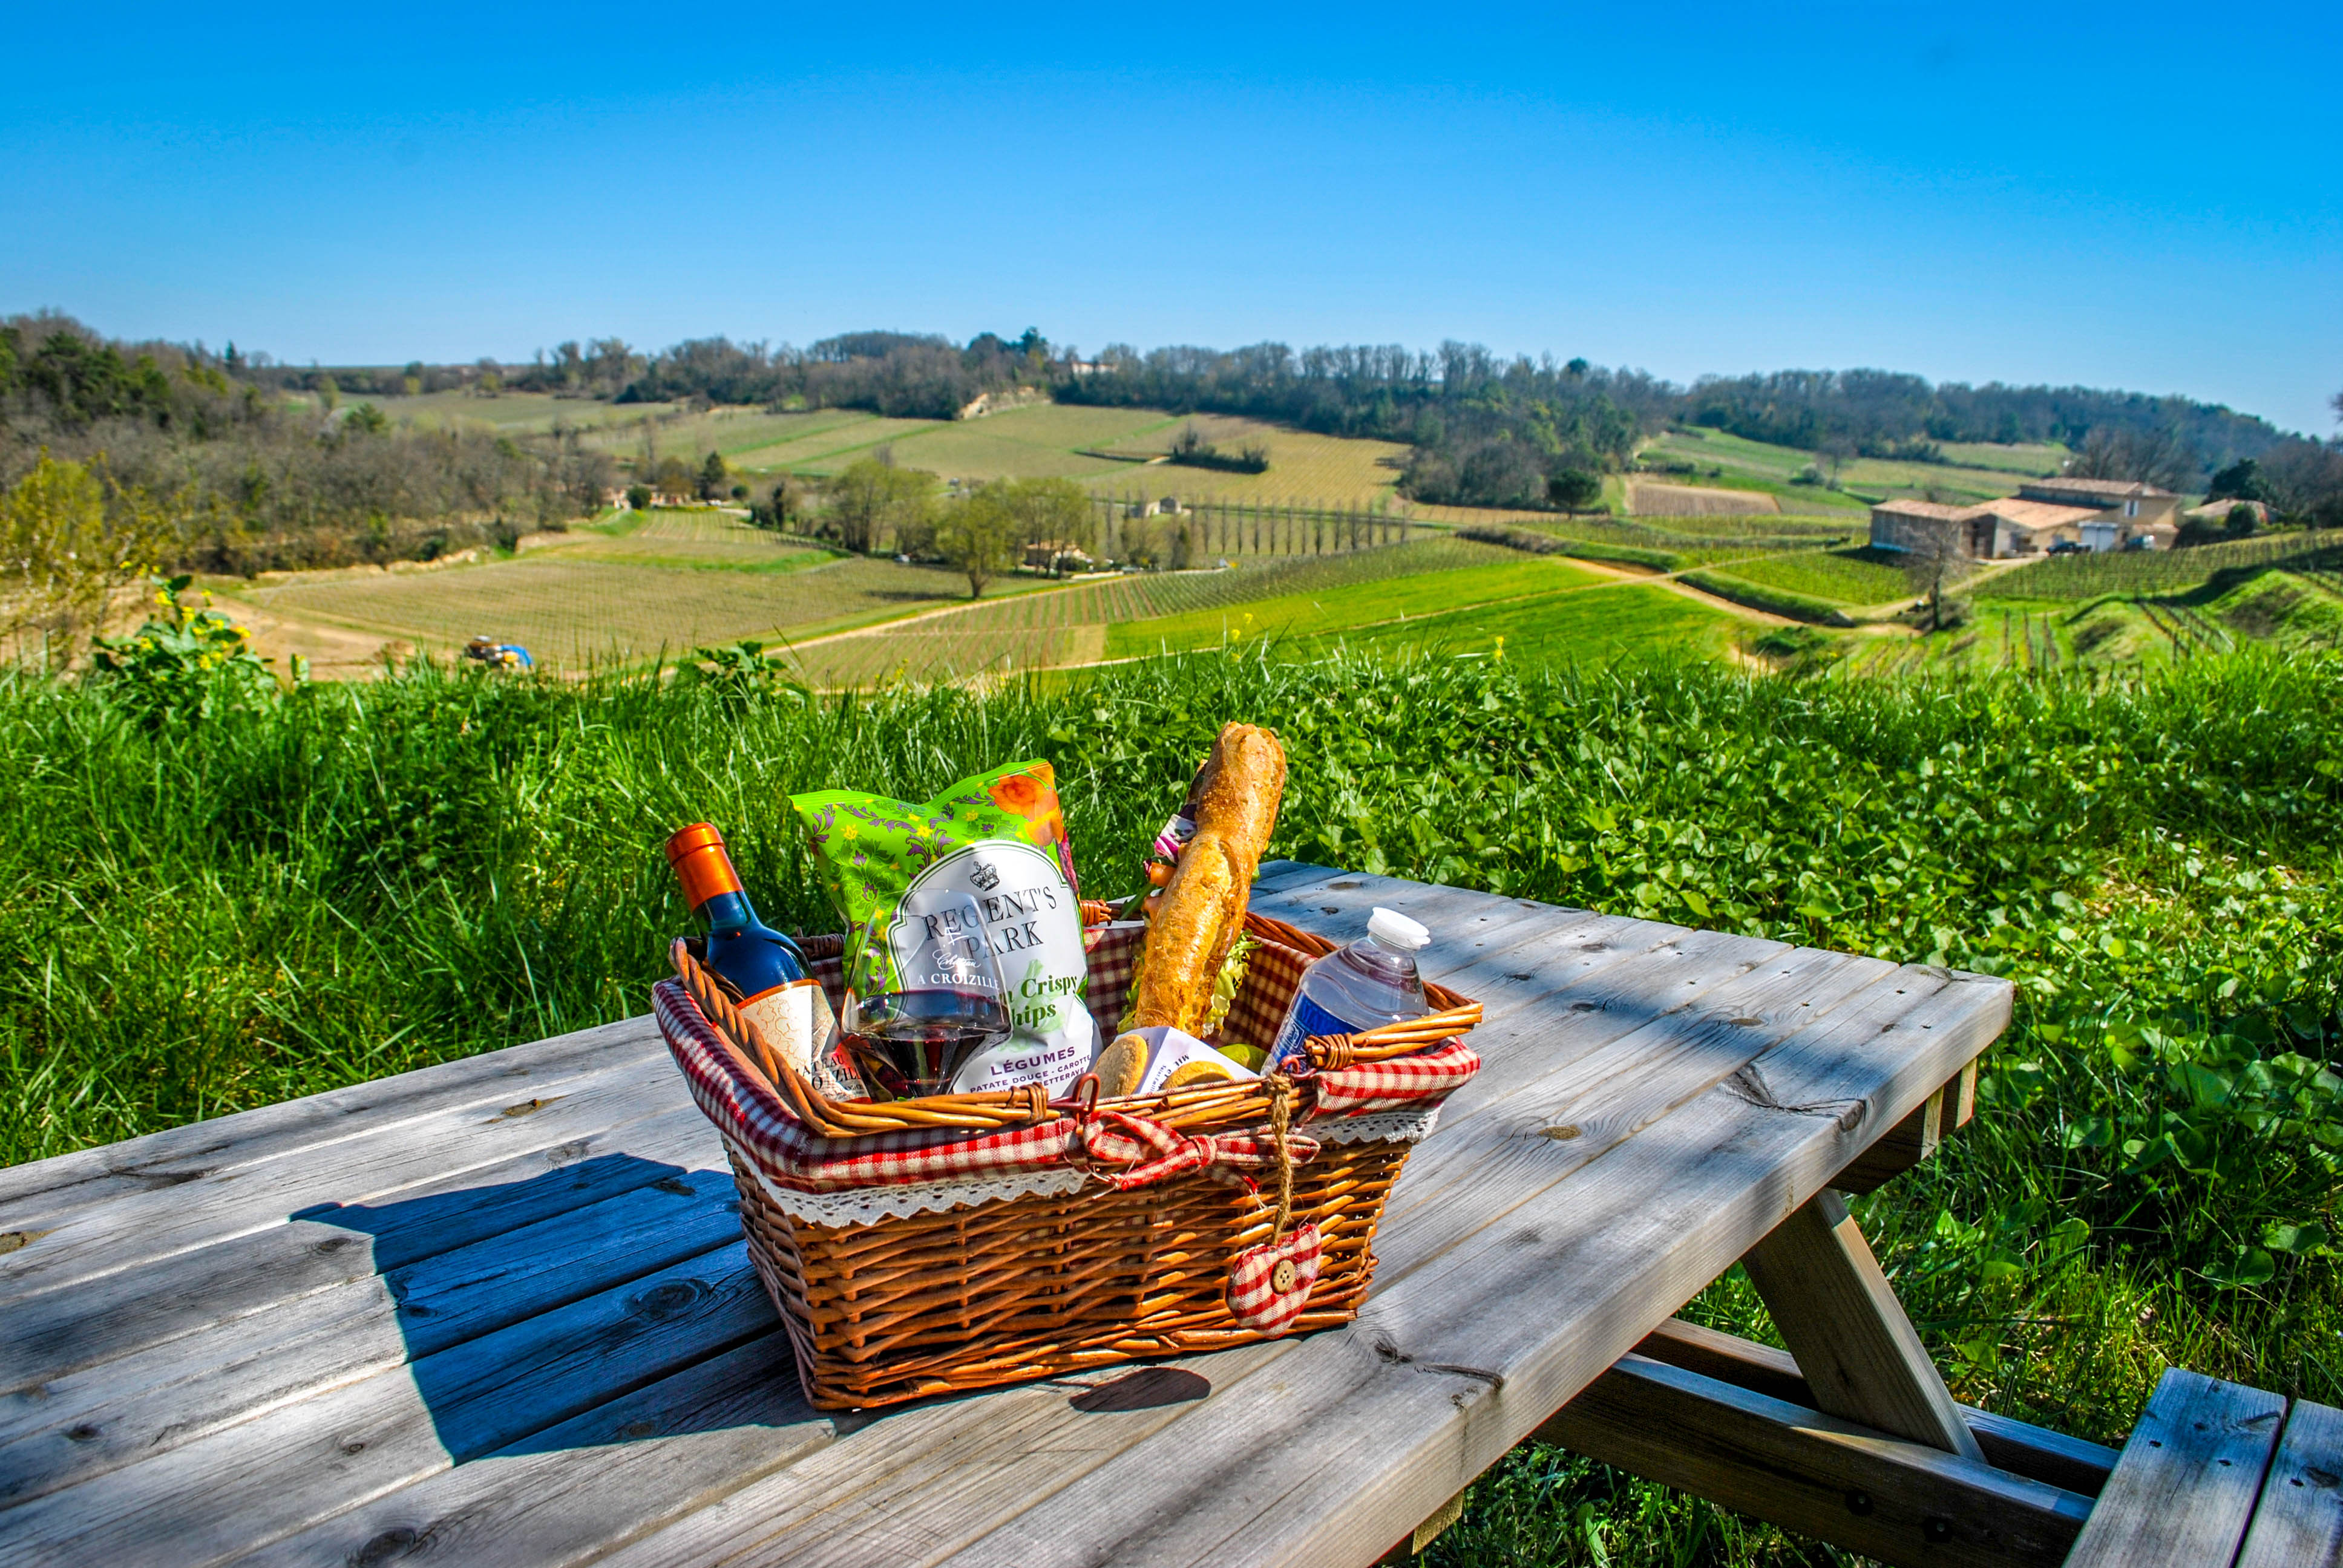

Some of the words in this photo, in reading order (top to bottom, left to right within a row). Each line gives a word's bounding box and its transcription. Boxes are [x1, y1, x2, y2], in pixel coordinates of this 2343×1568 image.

[922, 886, 1057, 941] REGENT'S
[965, 920, 1044, 960] PARK
[931, 973, 1000, 990] CROIZILLE
[1021, 975, 1077, 998] Crispy
[1012, 1004, 1057, 1028] hips
[796, 1054, 844, 1077] ATEAU
[991, 1047, 1075, 1076] LÉGUMES
[970, 1079, 1009, 1093] PATATE
[1012, 1071, 1049, 1084] DOUCE
[1043, 1067, 1084, 1086] ETTERAVE
